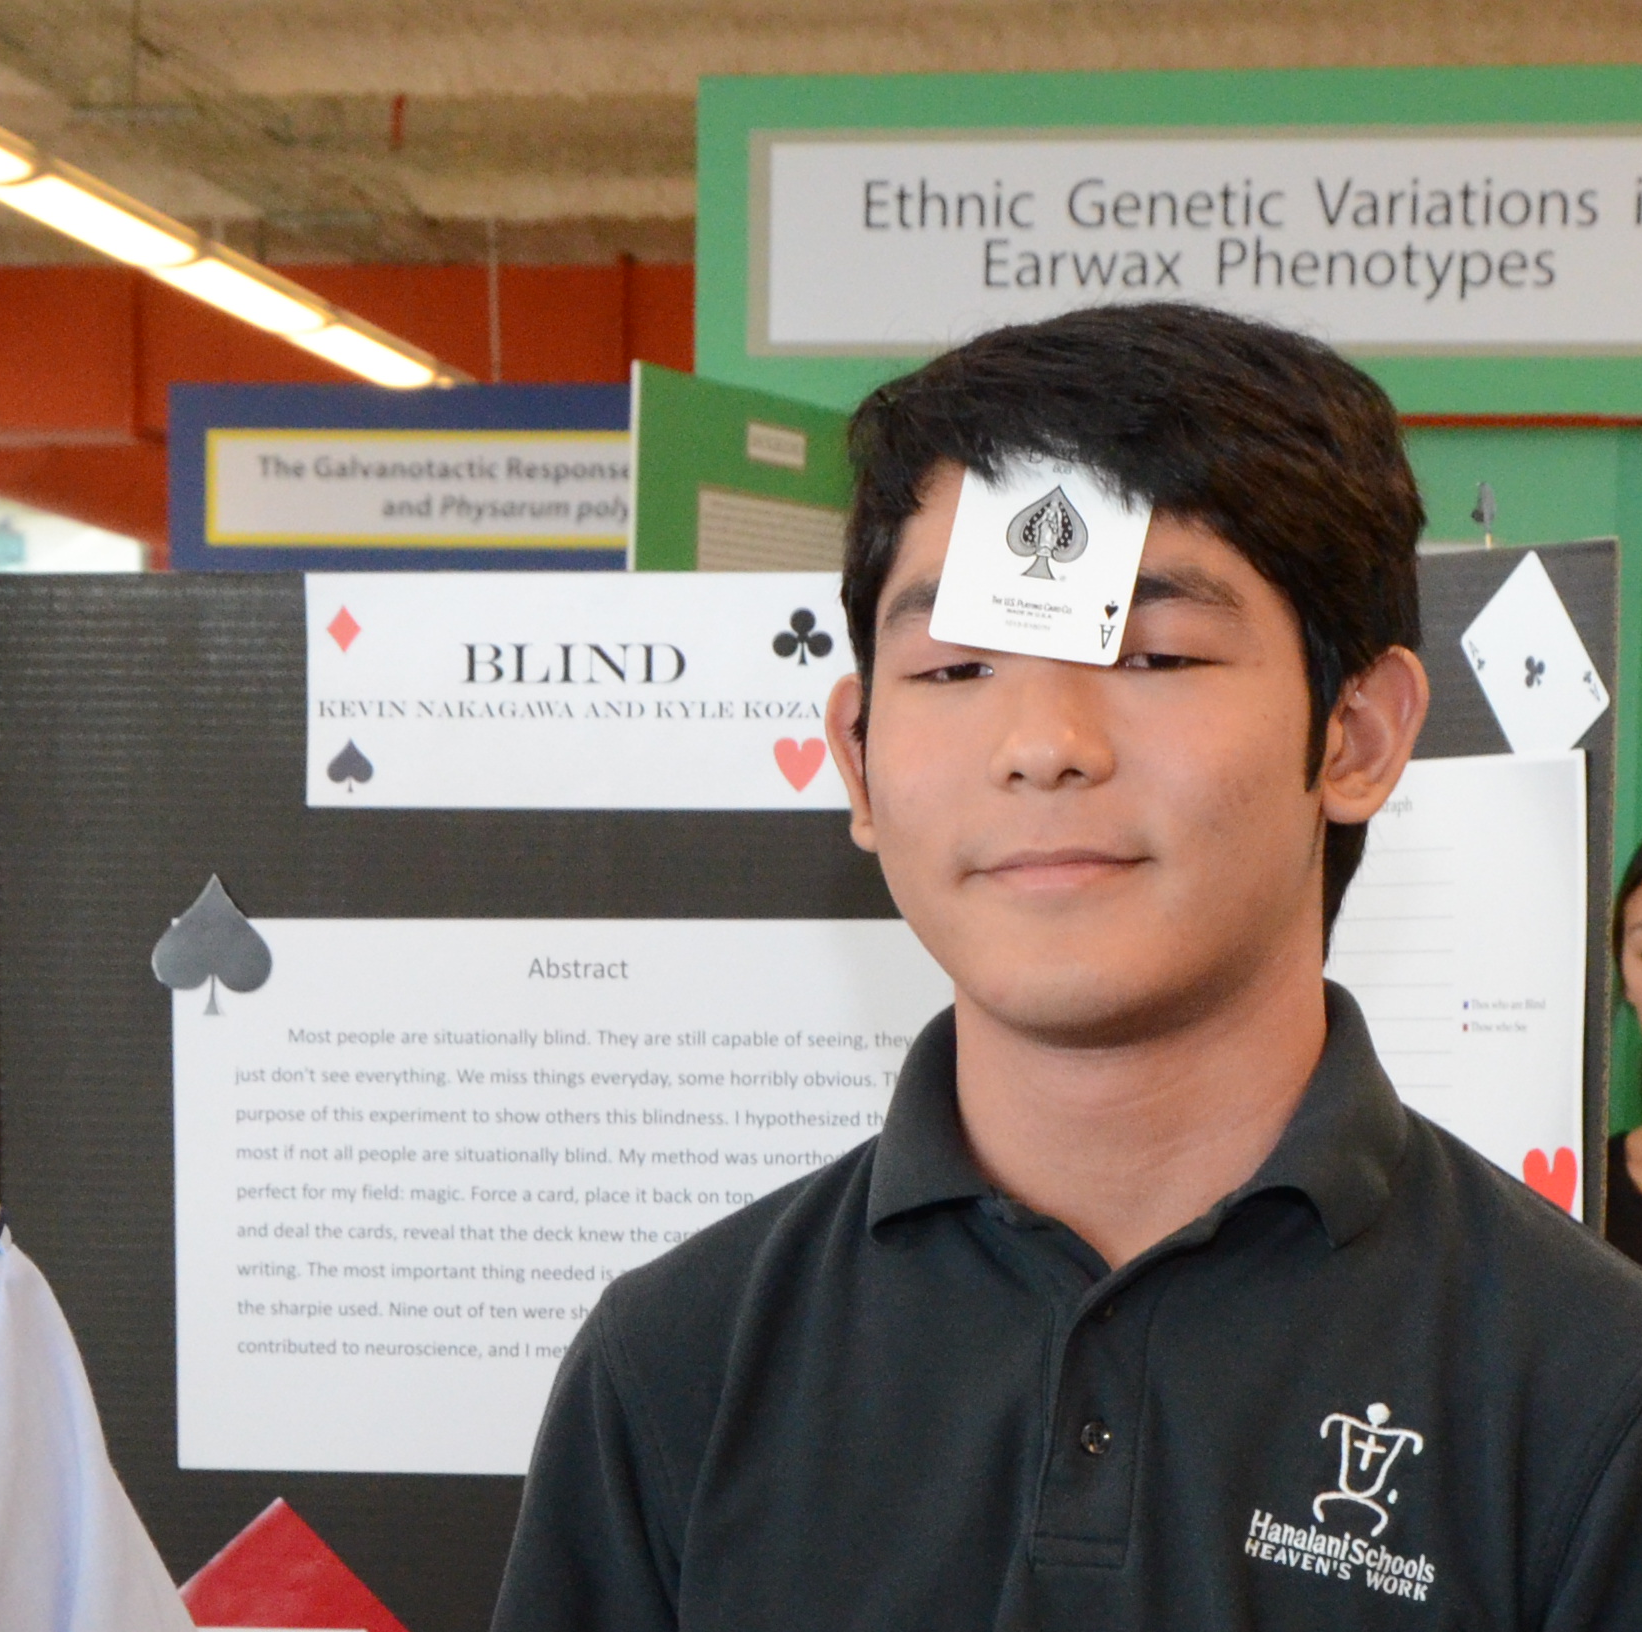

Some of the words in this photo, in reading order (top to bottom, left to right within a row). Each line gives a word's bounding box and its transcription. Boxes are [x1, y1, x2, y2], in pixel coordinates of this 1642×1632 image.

[863, 177, 1034, 231] Ethnic
[1066, 177, 1285, 231] Genetic
[1314, 177, 1599, 229] Variations
[982, 239, 1182, 289] Earwax
[1216, 237, 1556, 302] Phenotypes
[260, 455, 306, 479] The
[314, 456, 496, 480] Galvanotactic
[382, 497, 433, 518] and
[440, 495, 570, 522] Physarum
[575, 497, 627, 524] poly
[1100, 624, 1116, 650] A
[464, 643, 687, 684] BLIND
[318, 700, 406, 719] KEVIN
[417, 700, 575, 719] NAKAGAWA
[586, 700, 646, 719] AND
[656, 701, 735, 719] KYLE
[528, 957, 628, 980] Abstract
[288, 1028, 331, 1044] Most
[337, 1029, 395, 1046] people
[401, 1032, 428, 1044] are
[434, 1029, 538, 1048] situationally
[544, 1030, 590, 1045] blind.
[598, 1030, 638, 1049] They
[644, 1034, 671, 1046] are
[677, 1031, 706, 1046] still
[712, 1031, 779, 1049] capable
[784, 1031, 802, 1047] of
[808, 1035, 868, 1051] seeing,
[235, 1069, 265, 1085] just
[271, 1067, 315, 1083] don't
[322, 1071, 350, 1083] see
[355, 1068, 452, 1087] everything.
[457, 1069, 485, 1084] We
[490, 1071, 528, 1084] miss
[533, 1069, 585, 1089] things
[591, 1070, 672, 1088] everyday,
[678, 1074, 725, 1086] some
[730, 1070, 798, 1090] horribly
[803, 1071, 876, 1087] obvious.
[236, 1110, 305, 1128] purpose
[311, 1106, 328, 1122] of
[333, 1107, 364, 1122] this
[369, 1109, 466, 1125] experiment
[472, 1109, 490, 1123] to
[495, 1108, 540, 1124] show
[545, 1108, 600, 1124] others
[606, 1109, 637, 1125] this
[643, 1109, 728, 1125] blindness.
[735, 1111, 739, 1125] I
[745, 1110, 861, 1129] hypothesized
[236, 1147, 278, 1160] most
[284, 1144, 294, 1159] if
[300, 1148, 328, 1160] not
[334, 1146, 353, 1161] all
[358, 1146, 417, 1164] people
[422, 1150, 449, 1162] are
[455, 1147, 559, 1166] situationally
[565, 1148, 611, 1164] blind.
[619, 1148, 646, 1167] My
[651, 1149, 719, 1165] method
[725, 1153, 758, 1165] was
[237, 1183, 296, 1201] perfect
[302, 1183, 326, 1200] for
[332, 1188, 356, 1203] my
[362, 1184, 404, 1200] field:
[410, 1189, 464, 1205] magic.
[471, 1186, 517, 1202] Force
[522, 1190, 532, 1202] a
[537, 1187, 579, 1204] card,
[585, 1187, 630, 1206] place
[636, 1189, 647, 1203] it
[653, 1188, 692, 1204] back
[697, 1192, 719, 1204] on
[237, 1223, 268, 1238] and
[274, 1223, 309, 1238] deal
[315, 1223, 343, 1239] the
[348, 1224, 397, 1241] cards,
[403, 1225, 455, 1240] reveal
[460, 1225, 494, 1241] that
[500, 1225, 528, 1241] the
[533, 1226, 573, 1242] deck
[578, 1226, 625, 1242] knew
[630, 1227, 658, 1243] the
[237, 1263, 300, 1280] writing.
[308, 1262, 338, 1277] The
[344, 1265, 385, 1278] most
[391, 1265, 476, 1284] important
[482, 1264, 525, 1284] thing
[531, 1265, 595, 1281] needed
[600, 1266, 614, 1280] is
[237, 1300, 265, 1315] the
[271, 1301, 332, 1318] sharpie
[338, 1302, 385, 1317] used.
[389, 1302, 428, 1317] Nine
[433, 1304, 461, 1318] out
[467, 1302, 484, 1318] of
[489, 1305, 517, 1319] ten
[523, 1307, 565, 1320] were
[237, 1339, 337, 1355] contributed
[342, 1341, 360, 1355] to
[365, 1344, 482, 1359] neuroscience,
[488, 1342, 519, 1358] and
[525, 1343, 529, 1357] I
[1245, 1539, 1352, 1580] HEAVEN'S
[1366, 1569, 1427, 1601] WORK
